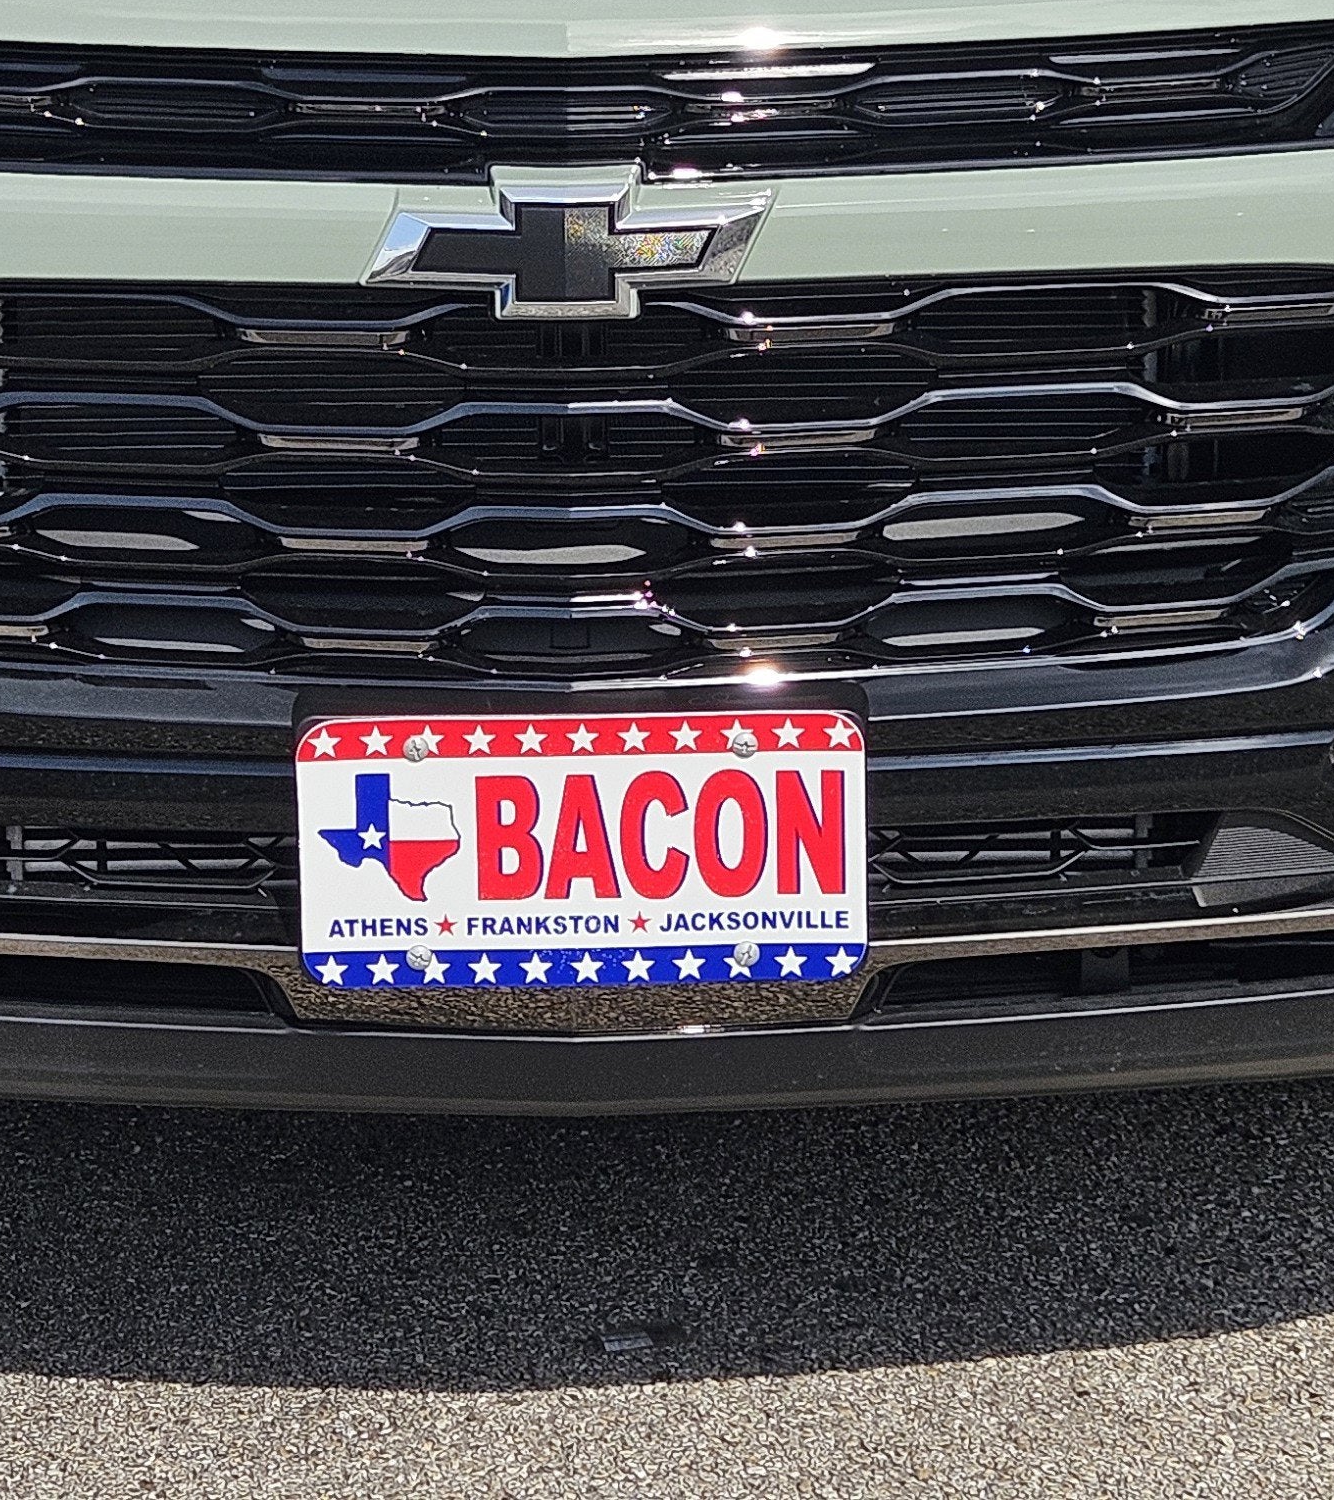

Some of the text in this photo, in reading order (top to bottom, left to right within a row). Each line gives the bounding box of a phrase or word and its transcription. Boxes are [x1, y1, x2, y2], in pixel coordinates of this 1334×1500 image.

[475, 769, 846, 901] BACON
[328, 910, 849, 938] ATHENS FRANKSTON JACKSONVILLE
